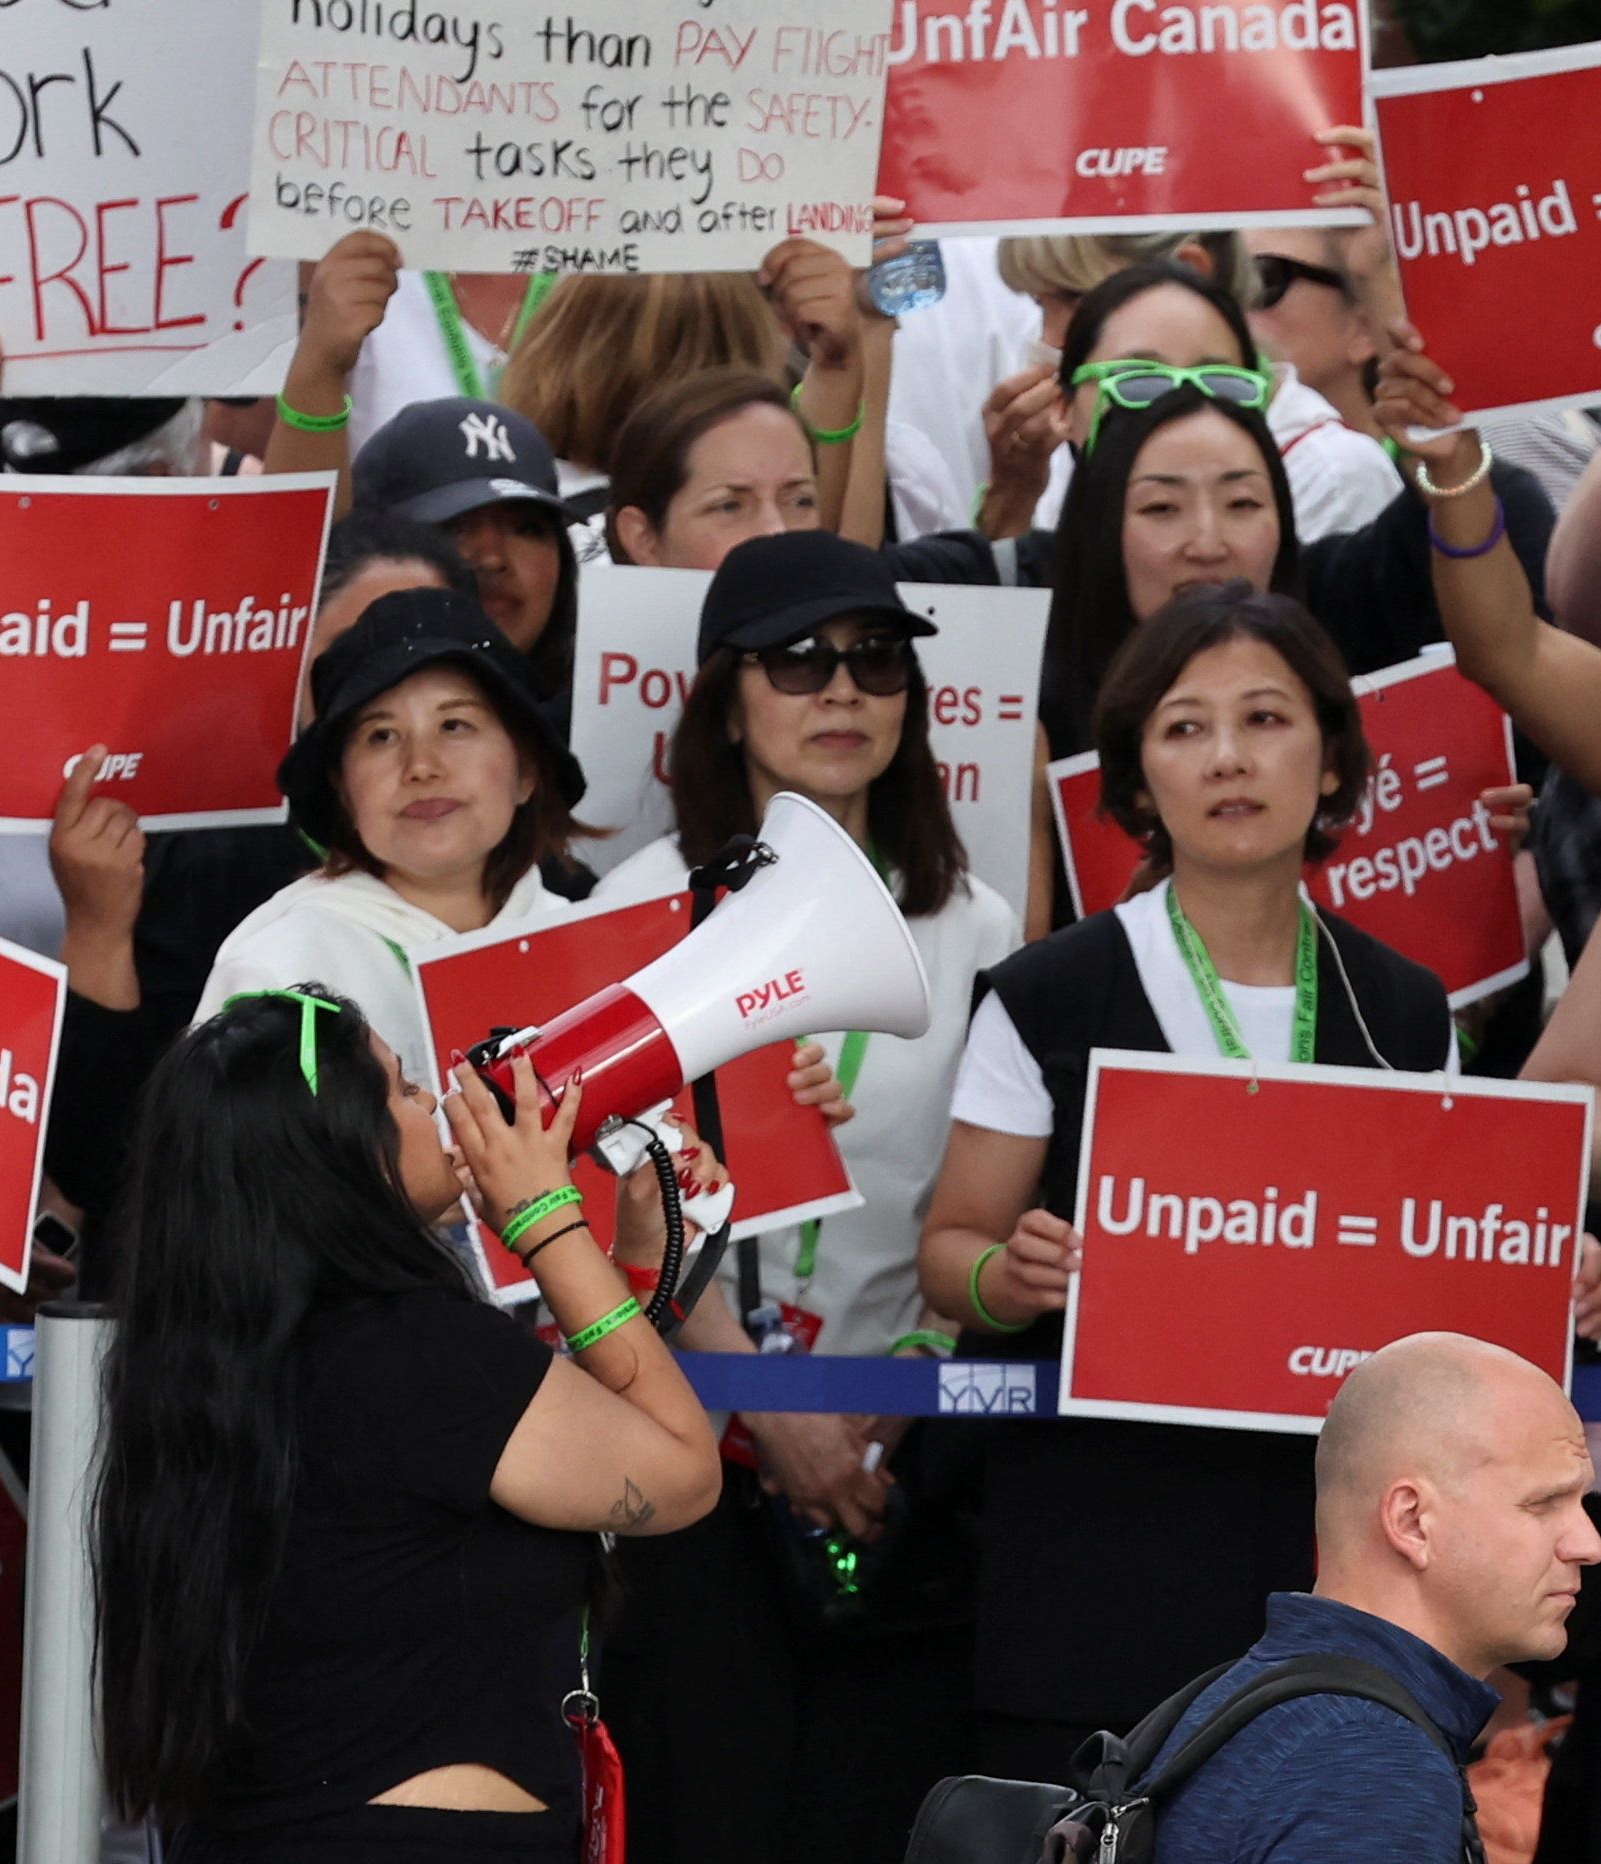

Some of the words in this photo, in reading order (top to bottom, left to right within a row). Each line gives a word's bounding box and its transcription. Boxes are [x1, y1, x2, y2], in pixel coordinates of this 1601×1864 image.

[535, 15, 652, 69] than
[674, 19, 759, 72] PAY
[1110, 0, 1358, 59] Canada
[277, 58, 560, 124] ATTENDANTS
[580, 83, 644, 132] for
[660, 81, 732, 128] the
[268, 108, 438, 179] CRITICAL
[464, 130, 597, 181] tasks
[618, 140, 715, 205] they
[737, 146, 786, 182] DO
[1074, 145, 1170, 178] CUPE
[432, 196, 607, 234] TAKEOFF
[697, 200, 779, 234] after
[1393, 181, 1578, 265] Unpaid
[509, 242, 640, 275] #SHAME
[165, 591, 310, 660] Unfair
[1326, 798, 1499, 908] respect
[1096, 1174, 1317, 1255] Unpaid
[1398, 1196, 1572, 1269] Unfair
[939, 1378, 1034, 1413] YVR
